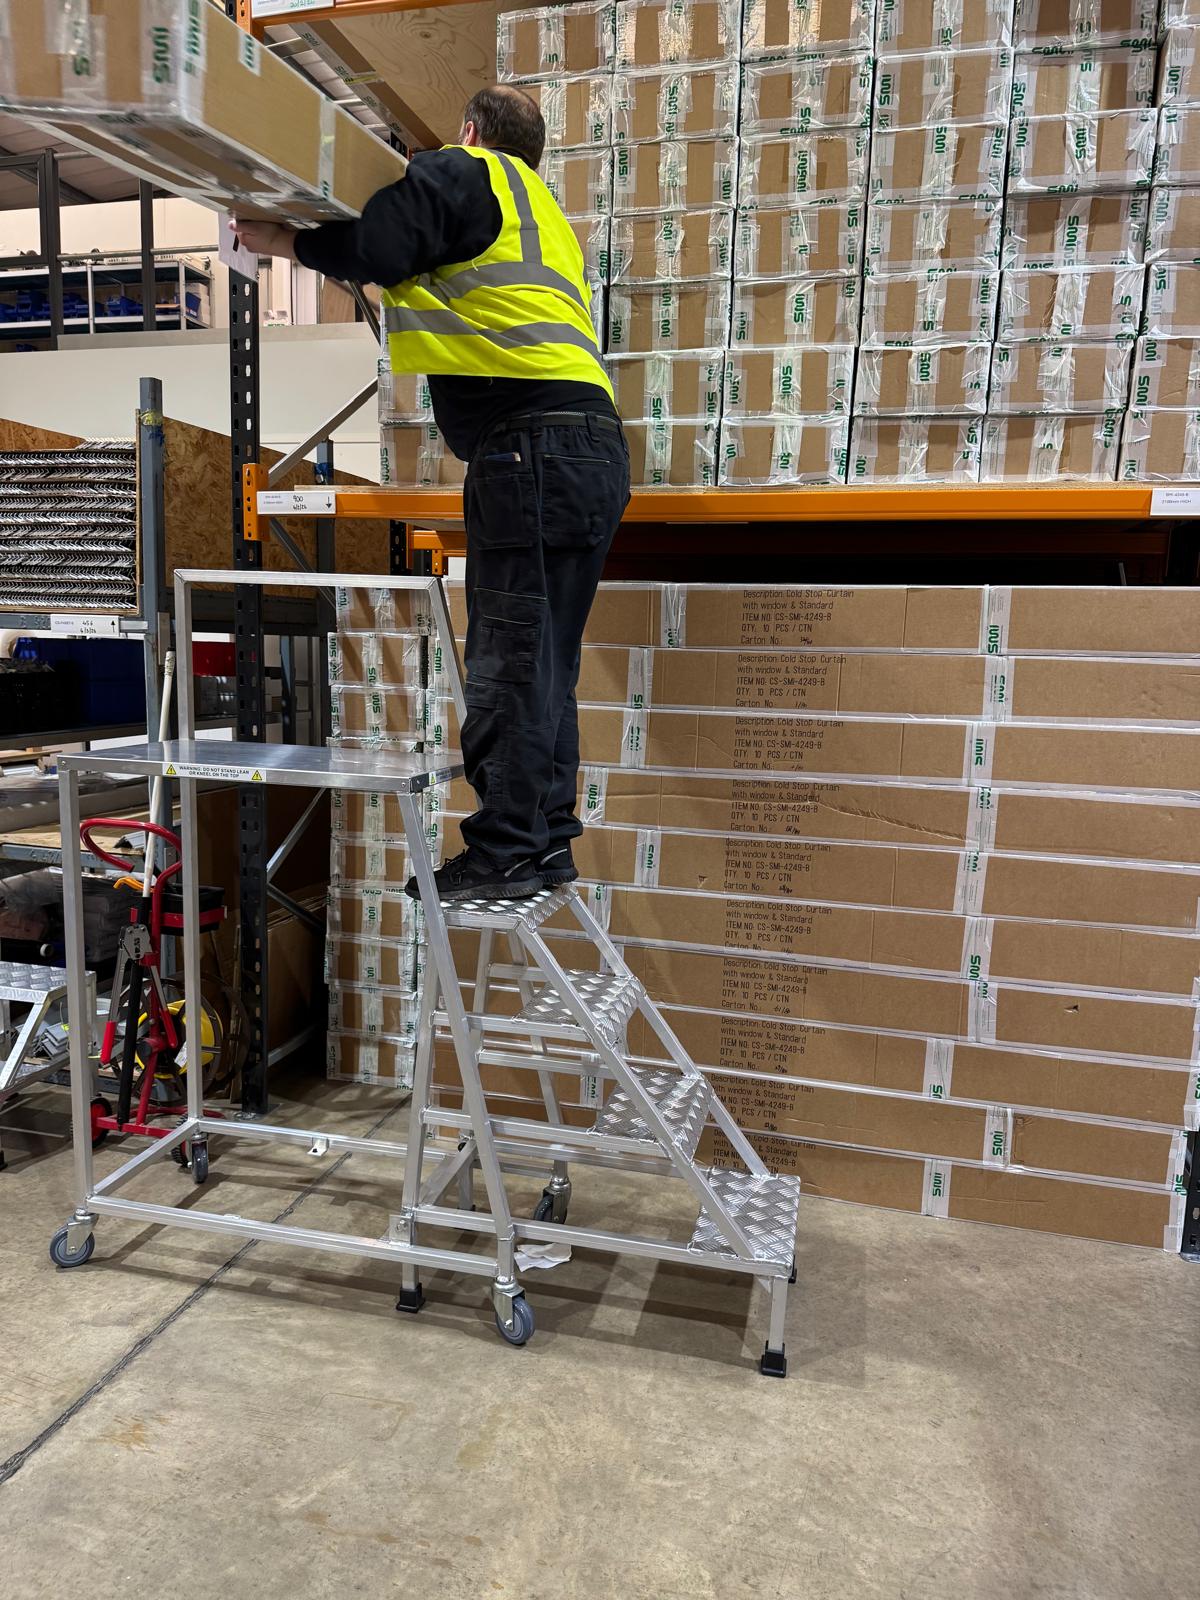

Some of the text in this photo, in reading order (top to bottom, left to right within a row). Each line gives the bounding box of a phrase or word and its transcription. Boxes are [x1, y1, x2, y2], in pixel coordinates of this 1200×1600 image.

[879, 74, 891, 106] SMI
[935, 126, 947, 154] SMI
[1075, 128, 1087, 159] SMI
[1064, 215, 1079, 249] SMI
[793, 294, 804, 324] SMI
[612, 319, 622, 344] SMI
[919, 352, 931, 384] SMI
[1136, 375, 1149, 405] SMI
[806, 590, 823, 598] Stop
[827, 590, 854, 598] Curtain
[743, 601, 758, 609] with
[761, 601, 787, 609] window
[800, 601, 833, 609] Standard
[742, 613, 759, 621] ITEM
[776, 624, 789, 632] PCS
[799, 624, 812, 632] CTN
[741, 636, 765, 644] Carton
[987, 625, 999, 654] SMI
[794, 666, 827, 675] Standard
[737, 677, 753, 685] ITEM
[758, 688, 763, 696] 10
[770, 688, 783, 696] PCS
[736, 699, 760, 707] Carton
[778, 718, 793, 726] Cold
[790, 729, 824, 738] Standard
[735, 739, 751, 747] ITEM
[755, 750, 761, 758] 10
[767, 751, 780, 759] PCS
[790, 751, 803, 759] CTN
[975, 739, 984, 766] SMI
[734, 761, 757, 769] Carton
[775, 781, 789, 789] Cold
[793, 782, 809, 790] Stop
[814, 783, 840, 791] Curtain
[587, 784, 598, 809] SMI
[805, 843, 831, 851] Curtain
[780, 852, 811, 861] Standard
[726, 860, 740, 868] ITEM
[744, 871, 751, 879] 10
[757, 871, 769, 880] PCS
[779, 873, 791, 882] CTN
[724, 881, 747, 890] Carton
[768, 902, 782, 910] Cold
[786, 904, 802, 912] Stop
[806, 905, 832, 914] Curtain
[764, 962, 779, 970] Cold
[803, 965, 828, 974] Curtain
[762, 1021, 777, 1029] Cold
[780, 1023, 796, 1031] Stop
[800, 1025, 825, 1034] Curtain
[721, 1027, 736, 1035] with
[738, 1029, 763, 1038] window
[774, 1032, 806, 1043] Standard
[721, 1038, 737, 1046] ITEM
[753, 1052, 764, 1060] PCS
[774, 1054, 787, 1062] CTN
[720, 1060, 743, 1068] Carton
[751, 1079, 765, 1087] Cold
[789, 1083, 815, 1093] Curtain
[993, 1131, 1004, 1156] SMI
[933, 1172, 942, 1197] SMI
